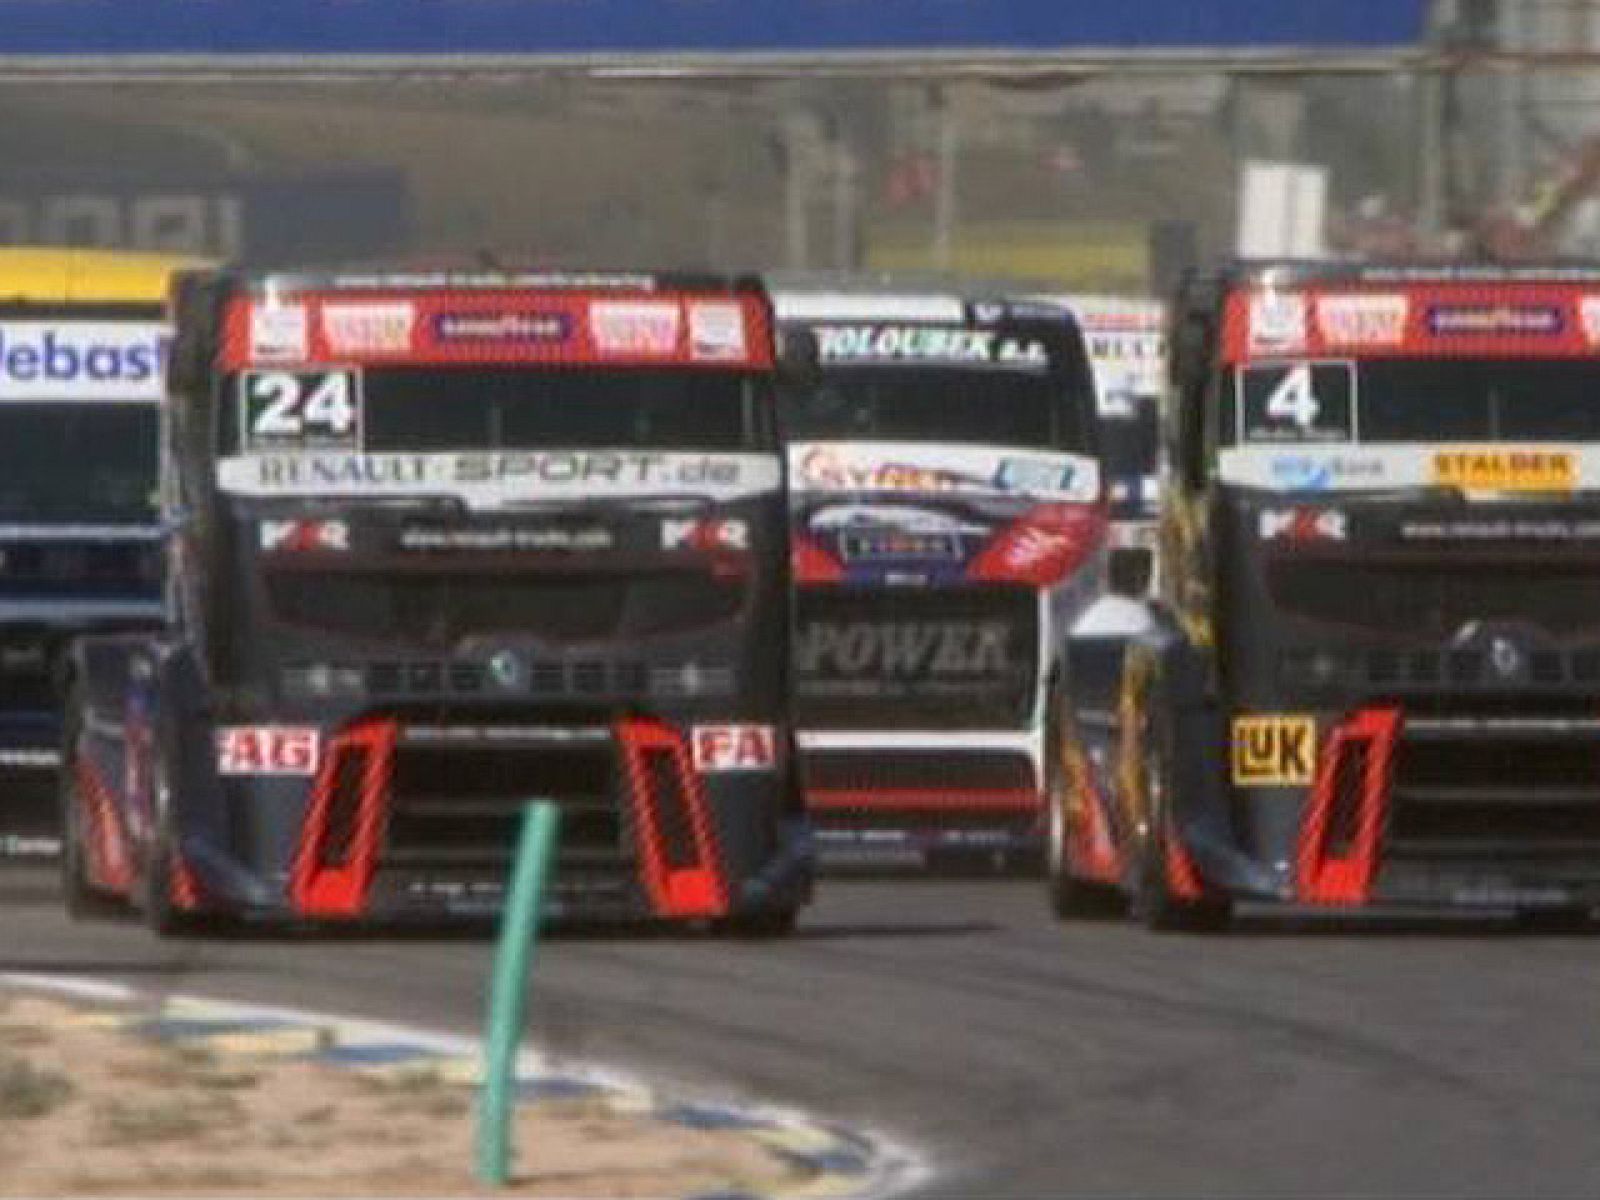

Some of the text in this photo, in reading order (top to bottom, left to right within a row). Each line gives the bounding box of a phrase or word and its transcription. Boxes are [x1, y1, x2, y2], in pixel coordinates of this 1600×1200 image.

[252, 373, 353, 434] 24
[1265, 363, 1320, 426] 4
[258, 457, 427, 484] RENAULT
[795, 621, 1014, 673] POWER
